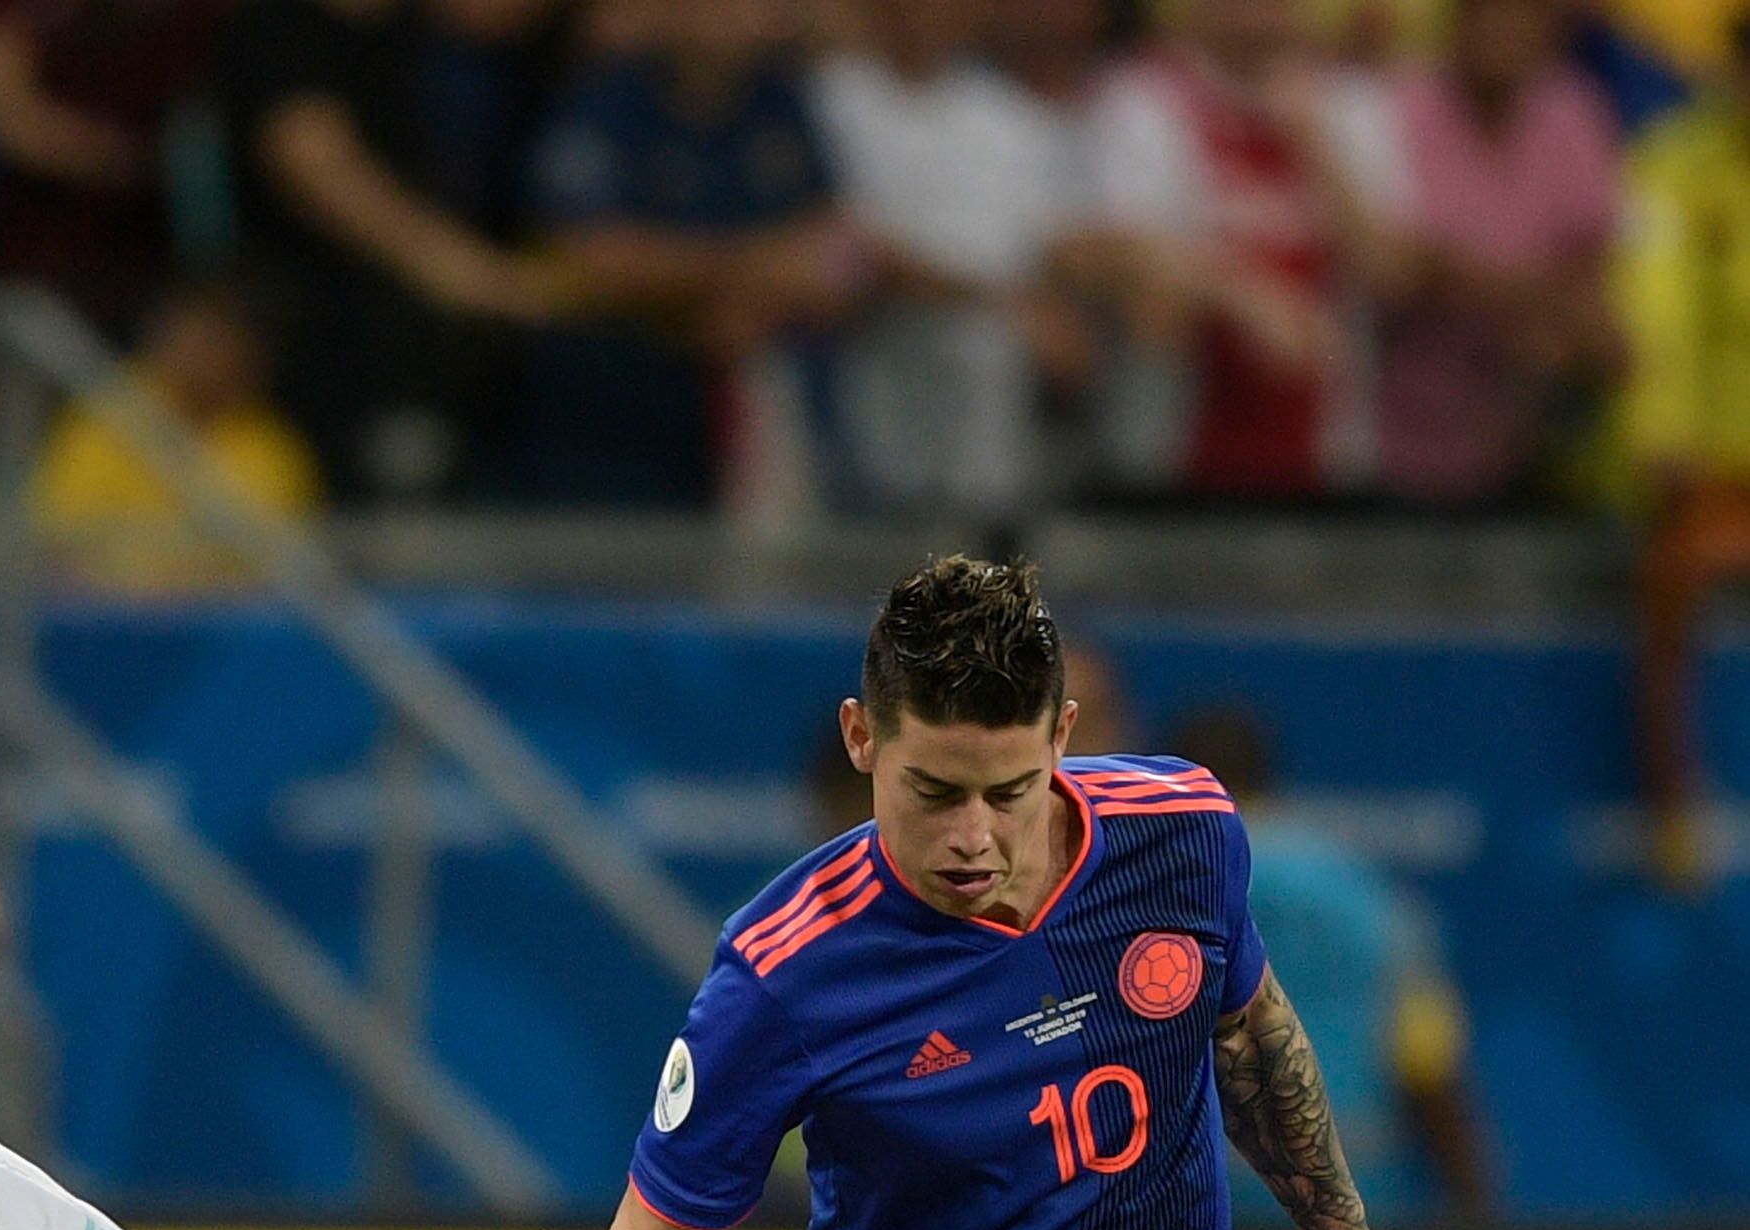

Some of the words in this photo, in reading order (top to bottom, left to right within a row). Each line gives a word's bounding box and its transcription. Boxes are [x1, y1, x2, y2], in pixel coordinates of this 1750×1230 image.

[1033, 1021, 1083, 1046] SALVADOR
[906, 1050, 971, 1079] adidas
[1028, 1064, 1149, 1184] 10
